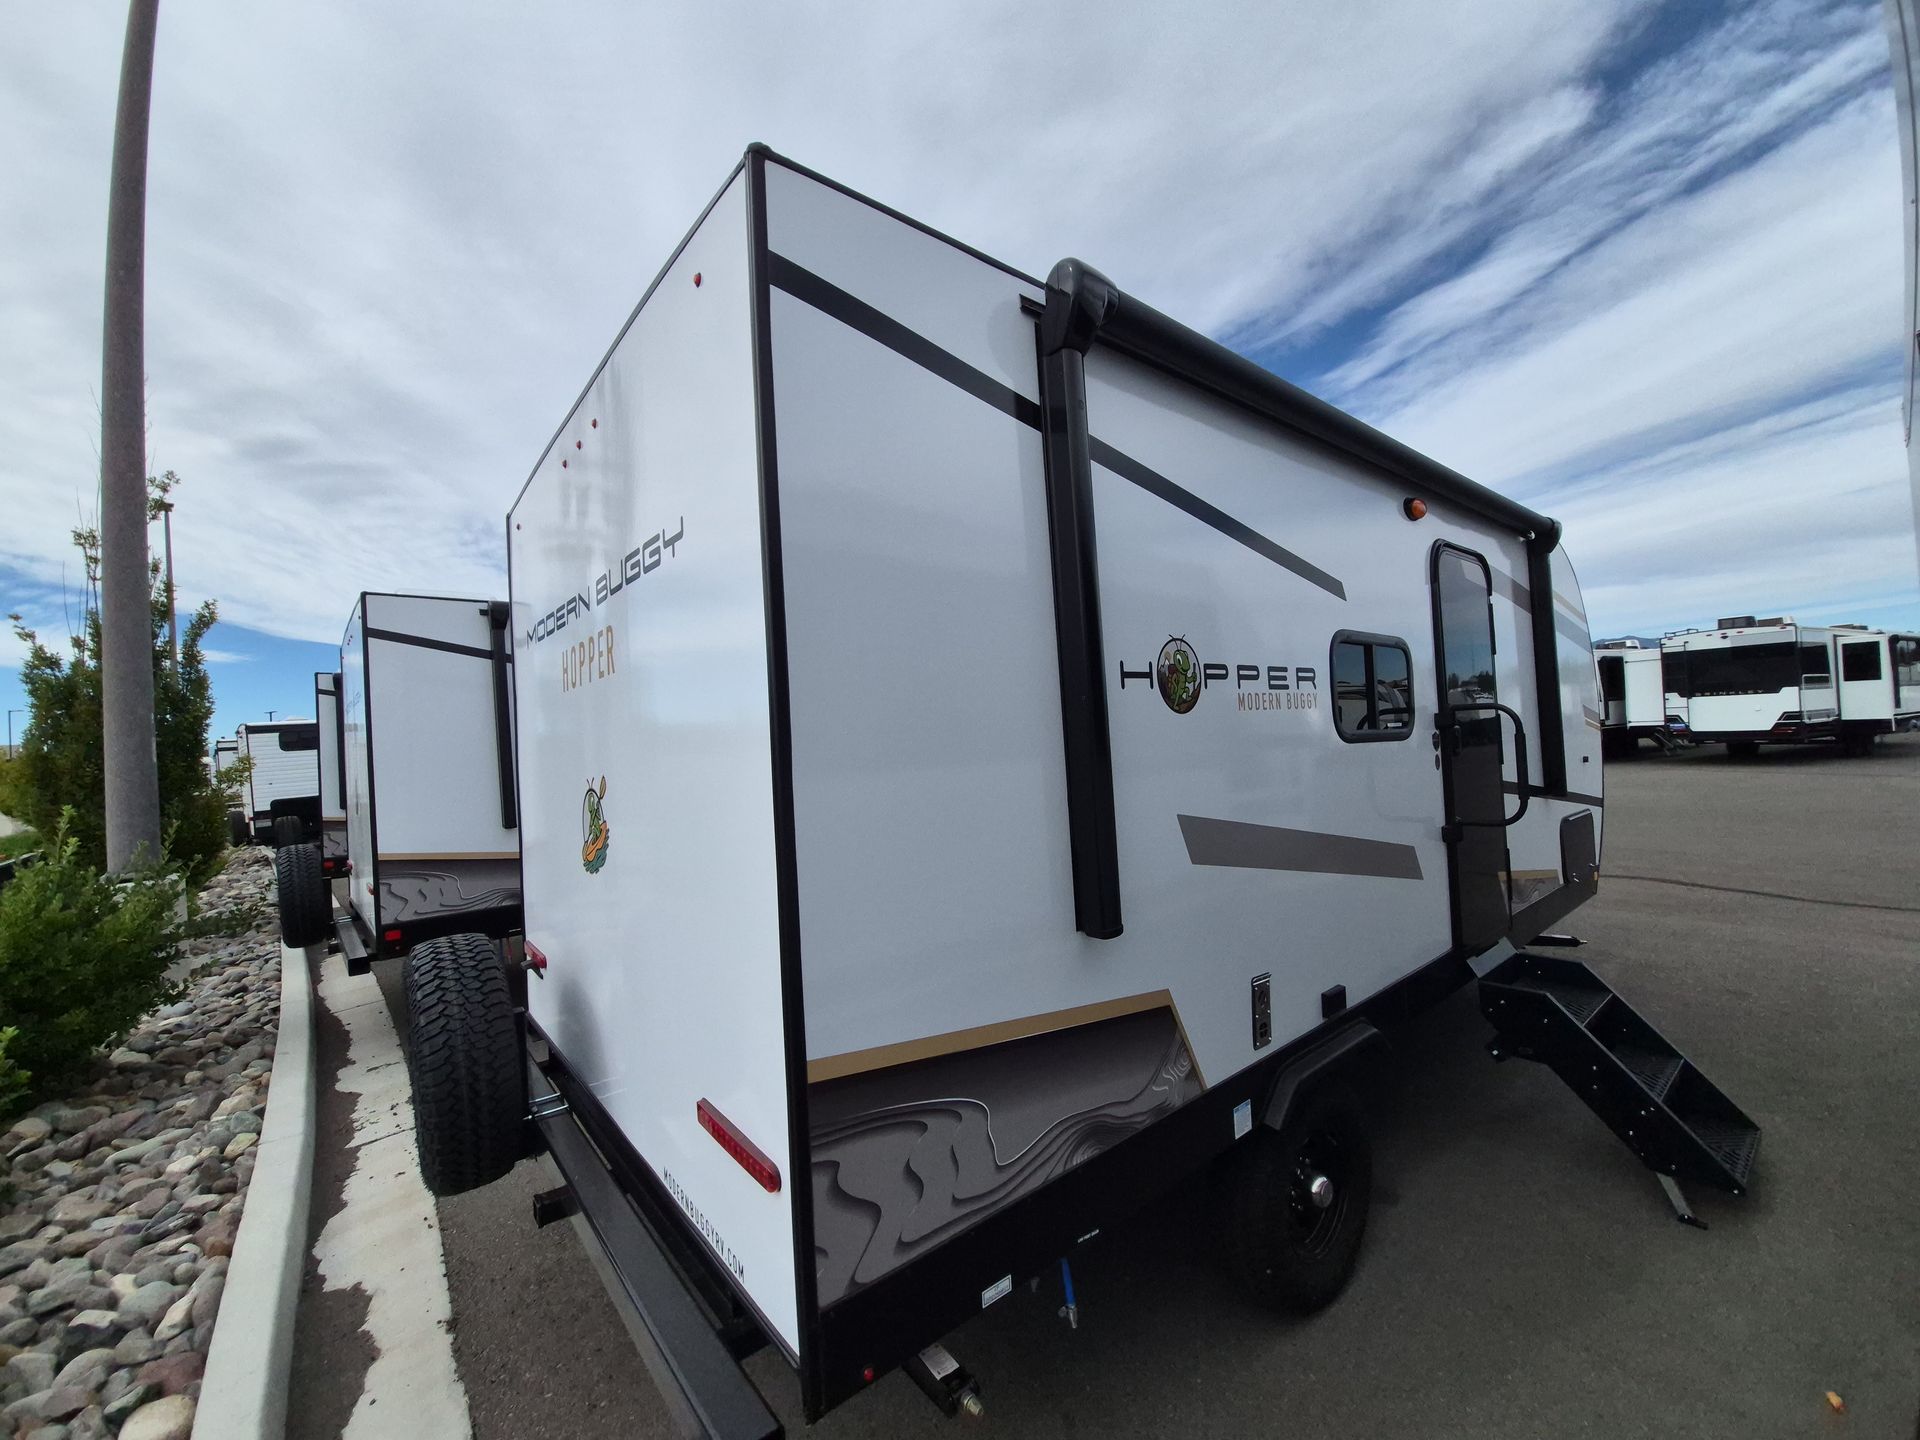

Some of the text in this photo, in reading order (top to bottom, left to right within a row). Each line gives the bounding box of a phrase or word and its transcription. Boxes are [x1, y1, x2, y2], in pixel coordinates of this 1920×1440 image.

[526, 515, 684, 649] MODERN BUGGY
[562, 624, 615, 693] HOPPER
[1237, 692, 1318, 711] MODERN BUGGY
[663, 1167, 745, 1283] MODERNBUGGYRV.COM
